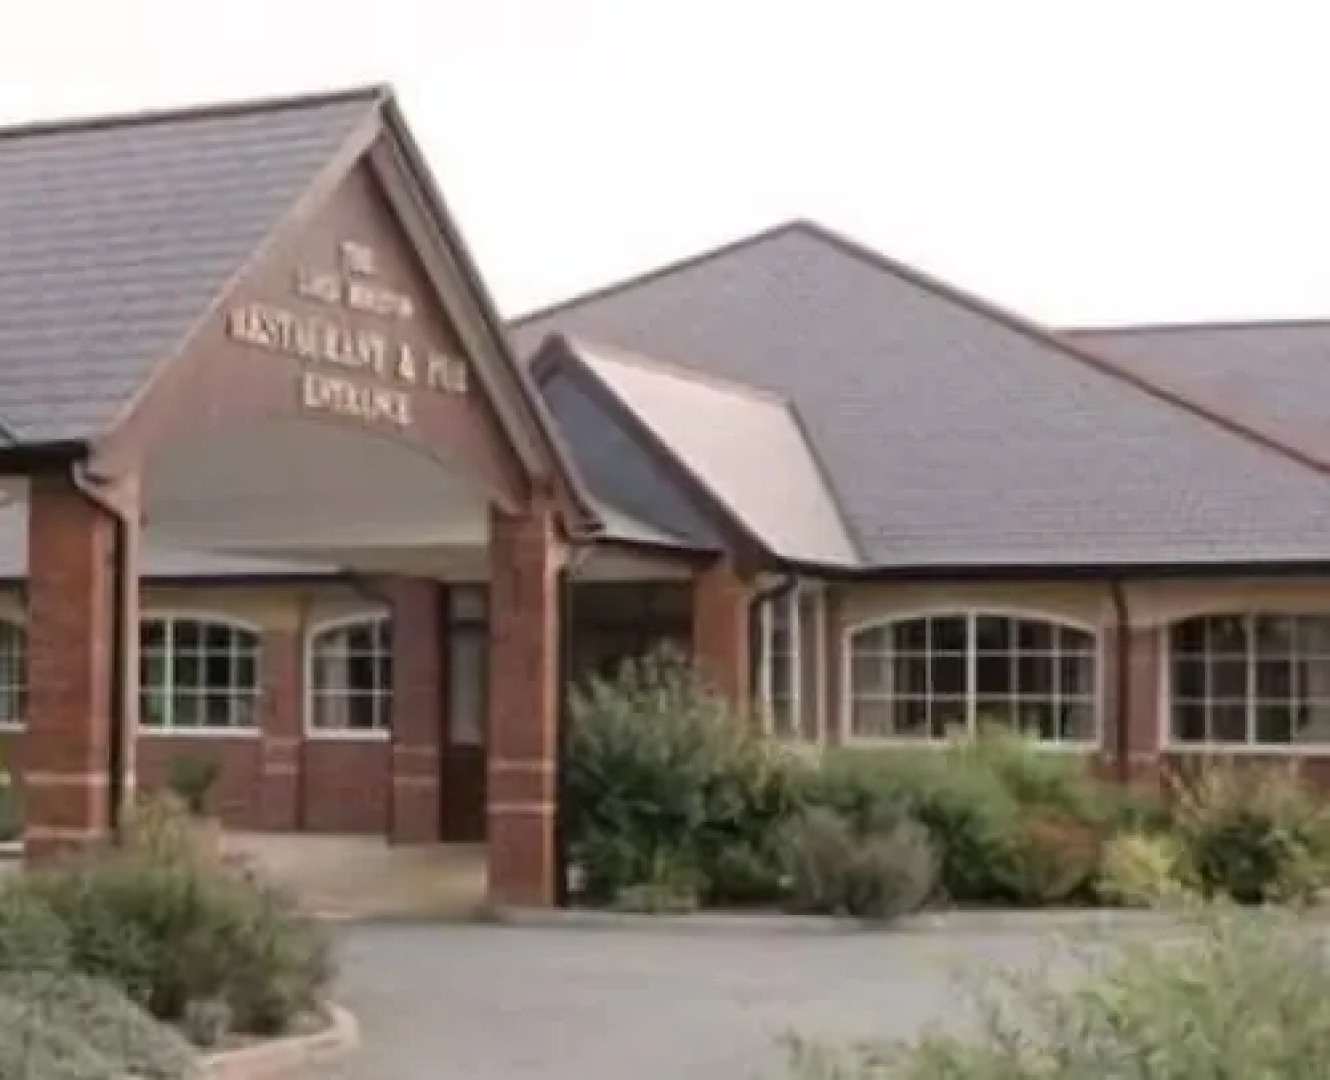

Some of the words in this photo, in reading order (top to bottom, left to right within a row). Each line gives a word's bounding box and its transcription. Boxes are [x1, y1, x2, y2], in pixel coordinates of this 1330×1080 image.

[226, 304, 386, 373] RESTAURANT
[397, 343, 417, 379] &
[304, 371, 414, 425] ENTRANCE
